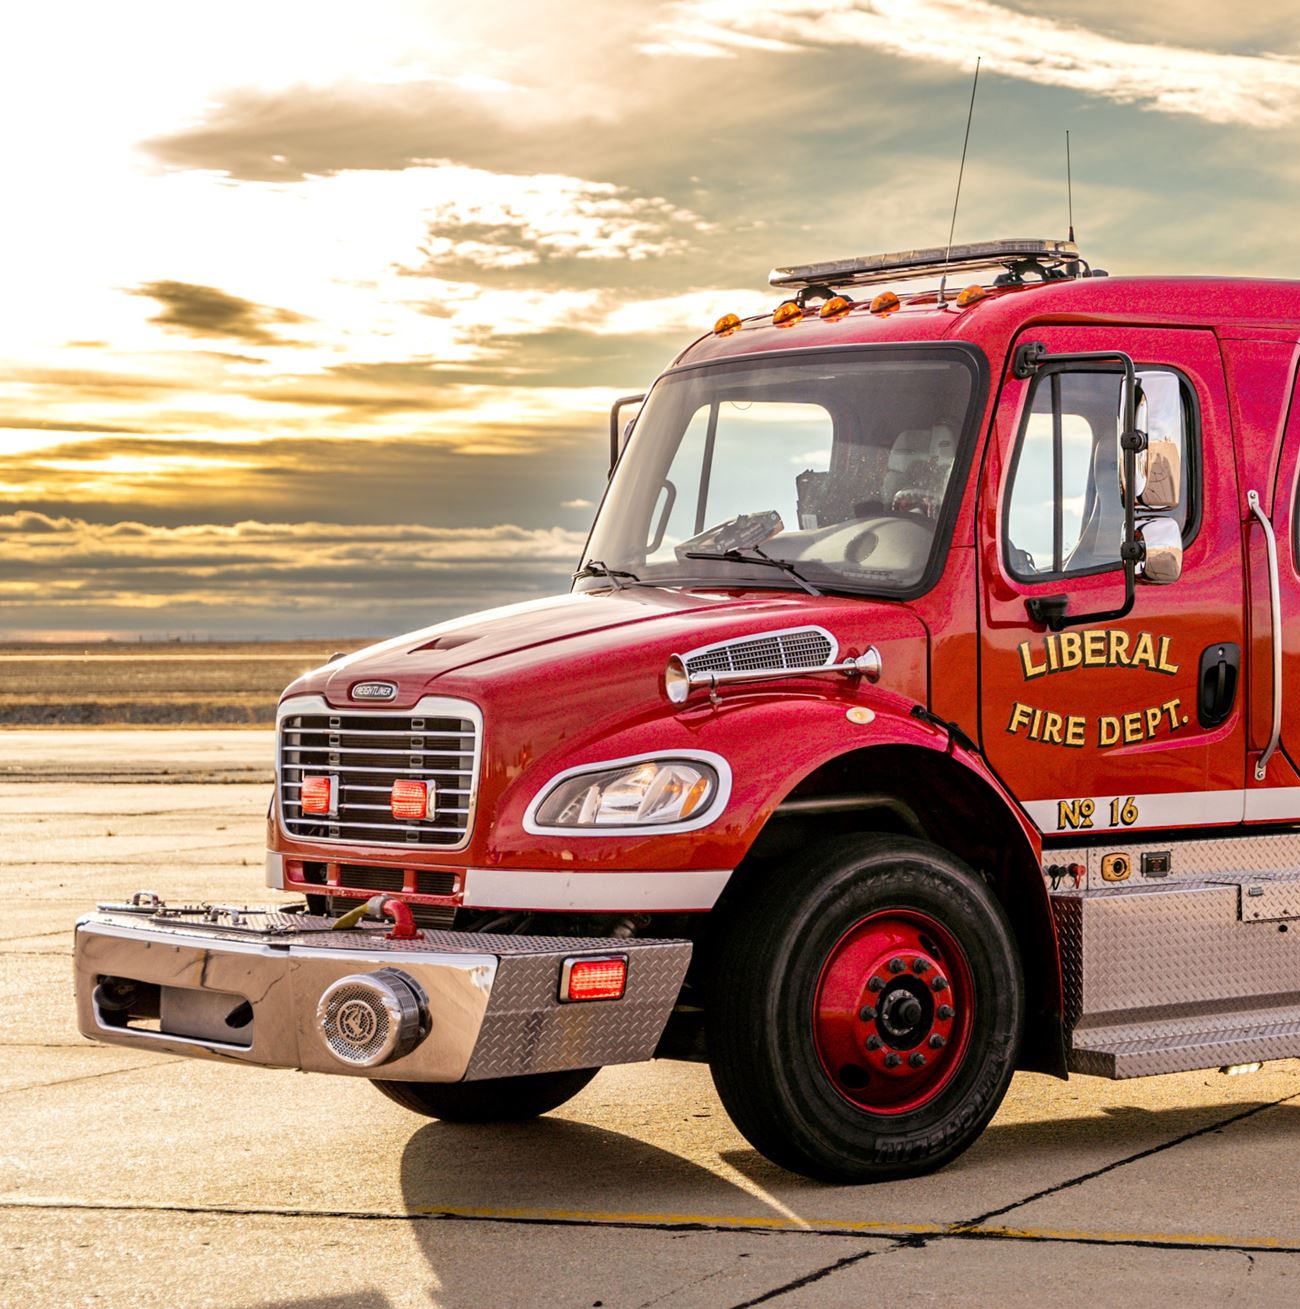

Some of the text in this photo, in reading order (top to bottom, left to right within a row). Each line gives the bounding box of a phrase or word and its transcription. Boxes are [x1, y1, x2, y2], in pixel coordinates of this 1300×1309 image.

[1019, 629, 1180, 681] LIBERAL
[354, 685, 393, 696] FREIGHTLINER
[1006, 698, 1190, 748] FIRE DEPT.
[1109, 796, 1139, 826] 16
